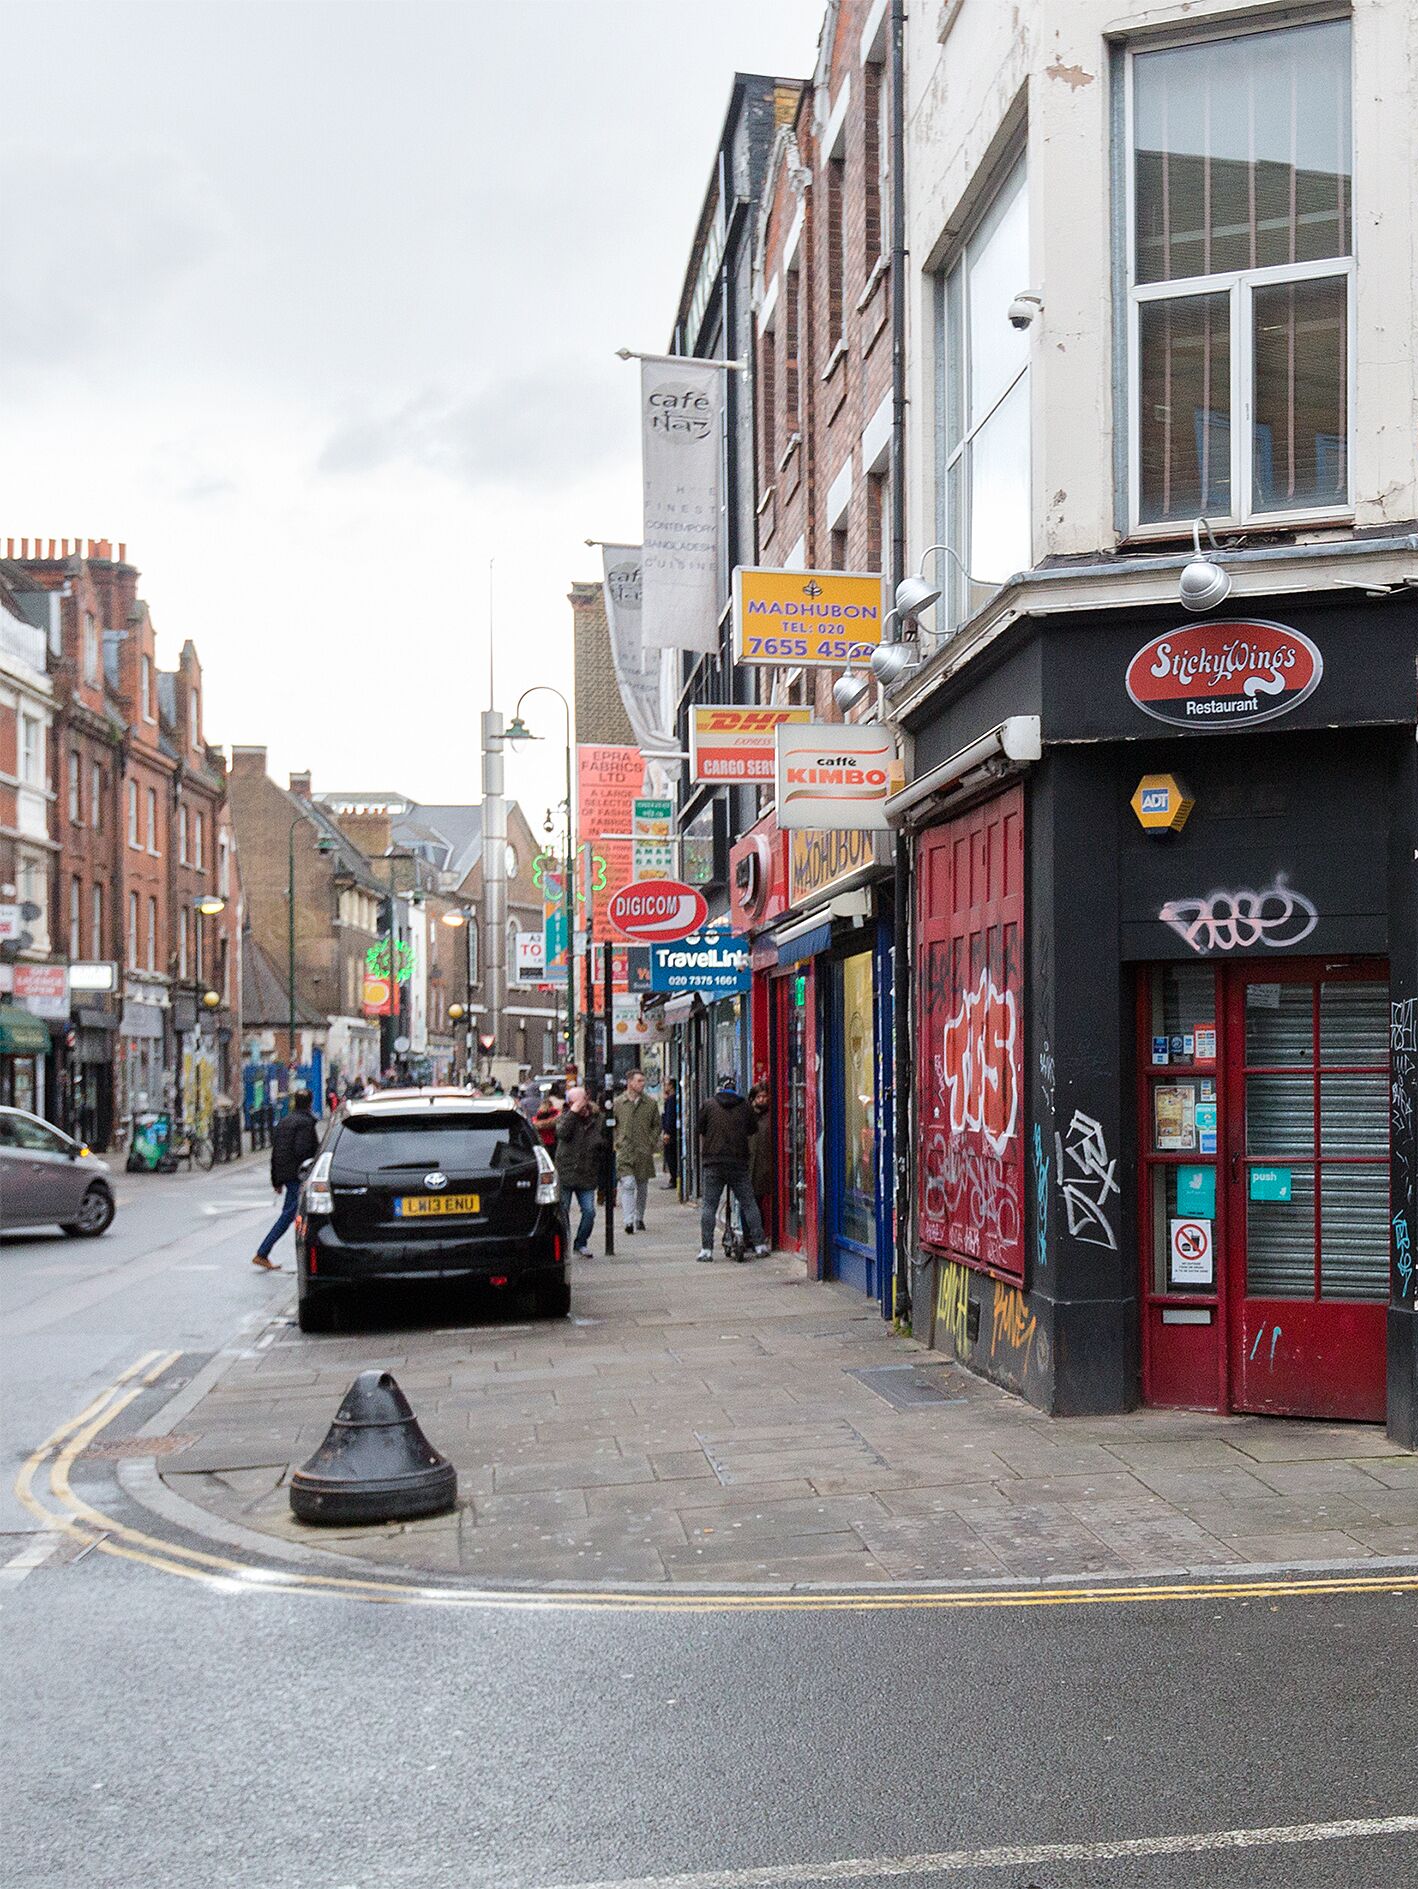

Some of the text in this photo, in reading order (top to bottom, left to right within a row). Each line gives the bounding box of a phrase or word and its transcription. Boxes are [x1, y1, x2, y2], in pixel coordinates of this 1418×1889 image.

[650, 392, 709, 410] café
[645, 501, 716, 514] FINEST
[748, 600, 877, 619] MADHUBON
[782, 621, 845, 635] TEL: 020
[748, 637, 808, 656] 7655
[1186, 698, 1258, 715] Restaurant
[733, 737, 772, 746] EXPRESS
[593, 751, 631, 761] EPRA
[816, 756, 857, 767] caffè
[581, 762, 643, 773] FABRICS
[703, 759, 745, 775] CARGO
[599, 772, 626, 782] LTD
[786, 768, 886, 785] KIMBO
[1142, 791, 1169, 809] ADT
[615, 895, 677, 917] DIGICOM
[668, 975, 687, 986] 020
[1252, 1171, 1277, 1183] push
[445, 1197, 474, 1212] ENU
